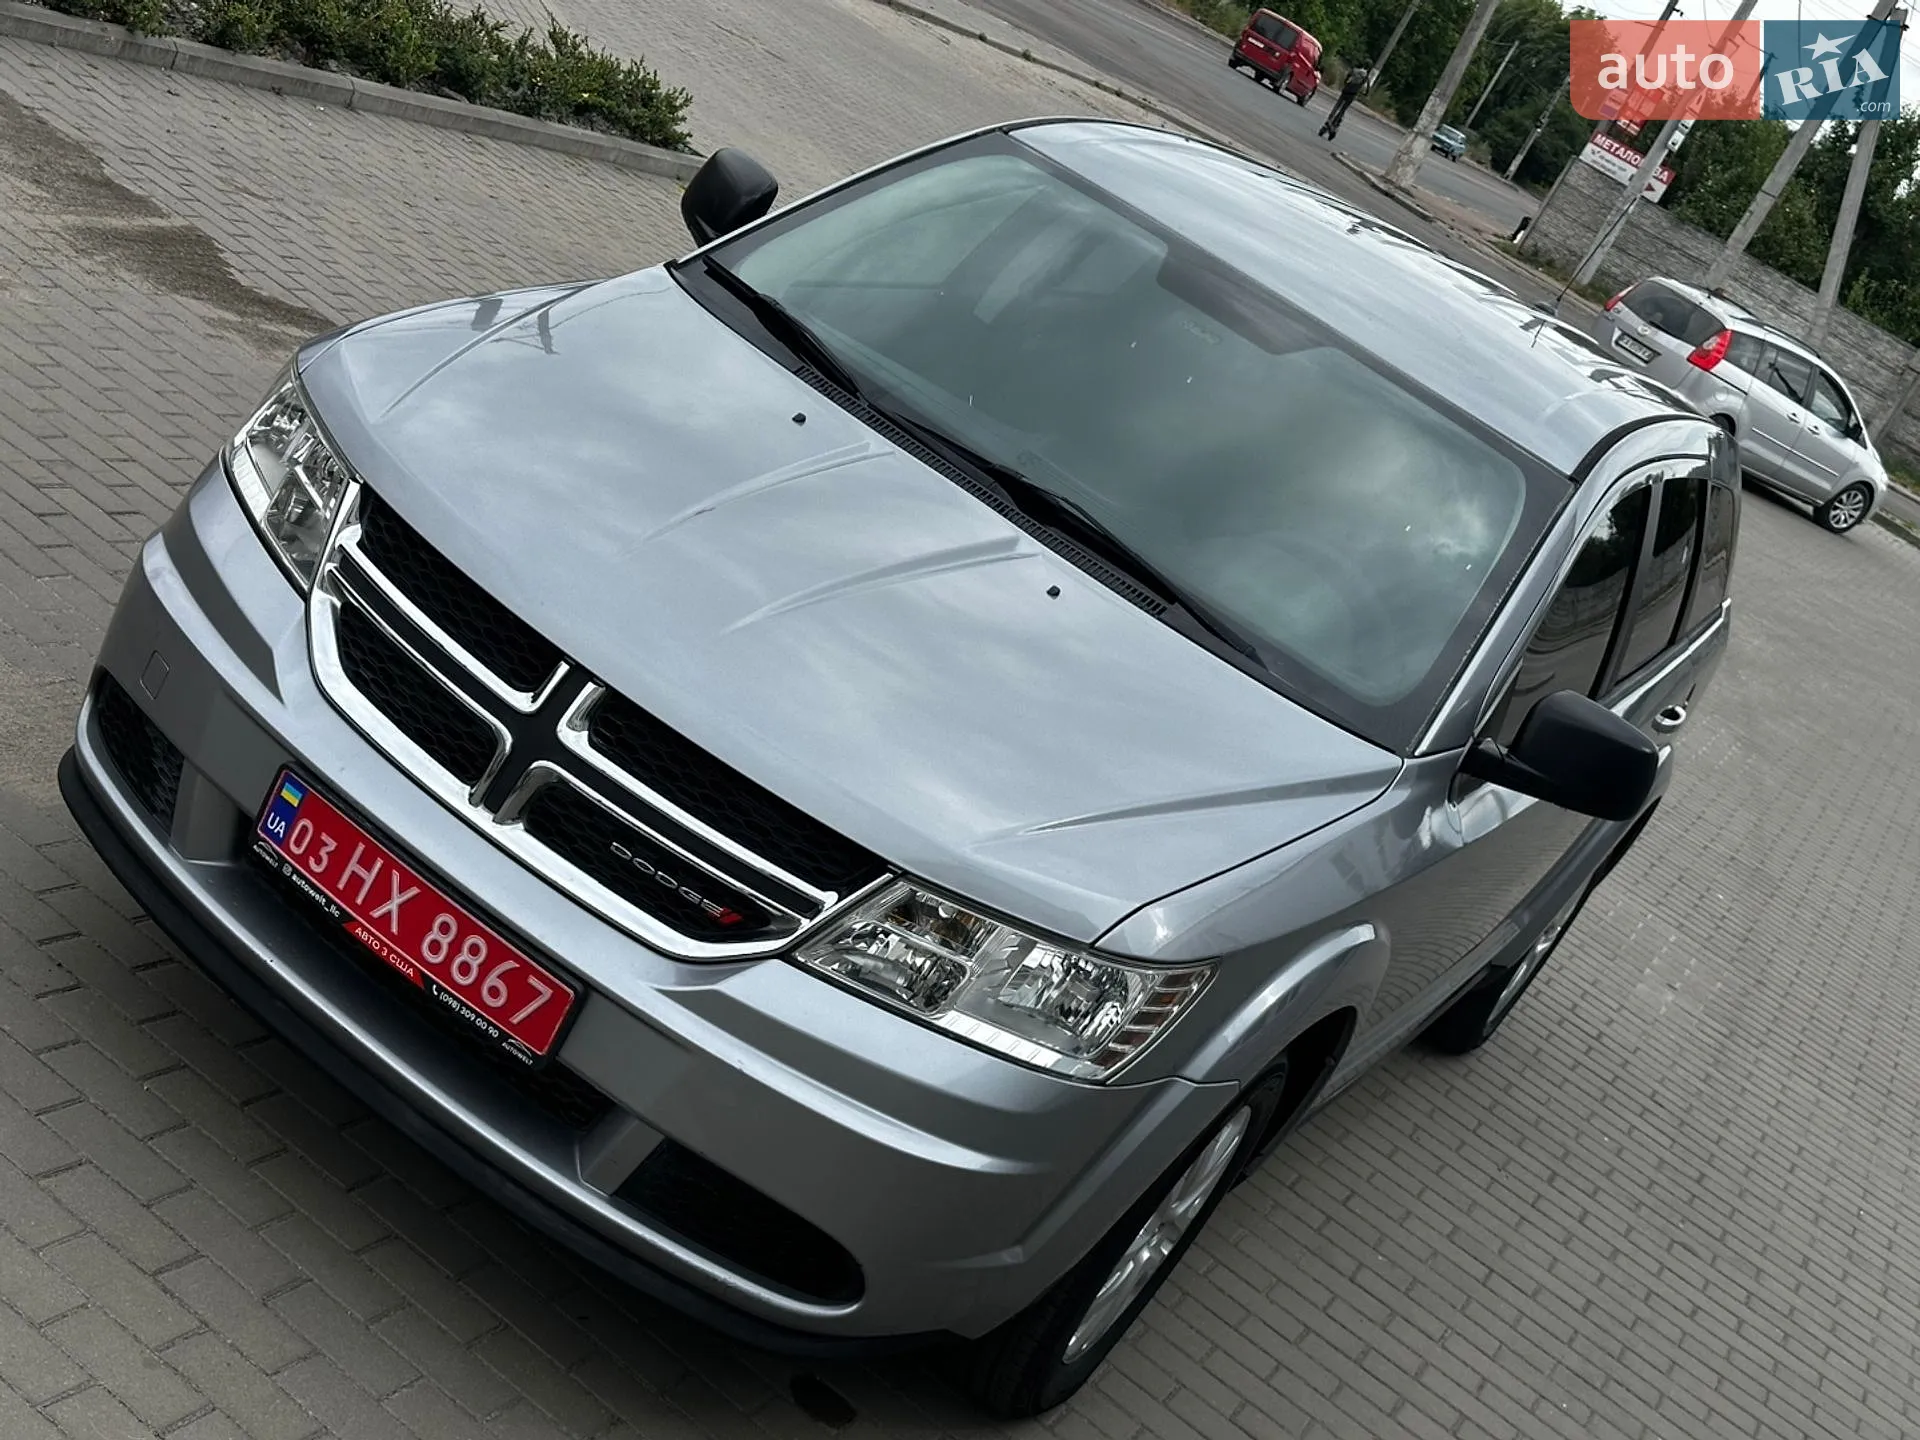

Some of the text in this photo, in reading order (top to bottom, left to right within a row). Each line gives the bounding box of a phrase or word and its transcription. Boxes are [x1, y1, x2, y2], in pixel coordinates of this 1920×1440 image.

[267, 812, 286, 838] UA
[610, 841, 724, 917] DODGE
[288, 818, 554, 1025] 03 HX 8867
[355, 927, 380, 950] АВТО
[389, 953, 414, 977] США
[439, 992, 499, 1038] (098) 309 00 90
